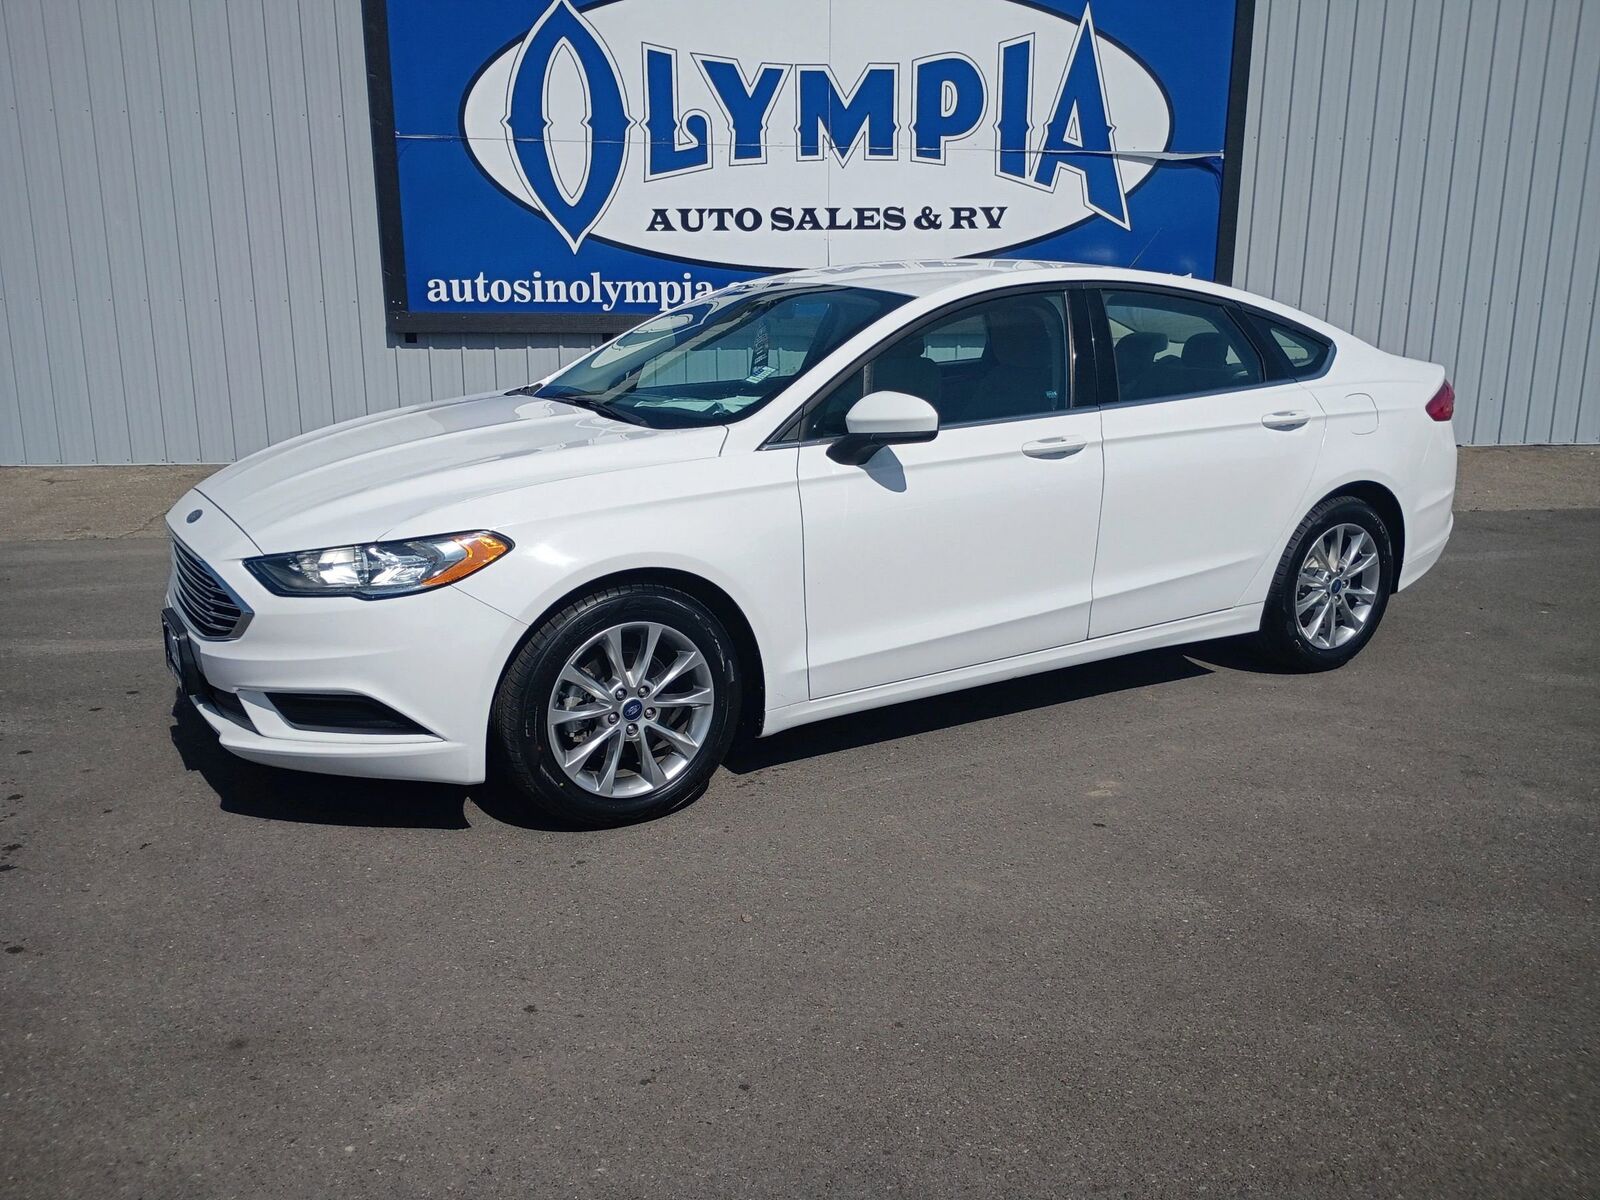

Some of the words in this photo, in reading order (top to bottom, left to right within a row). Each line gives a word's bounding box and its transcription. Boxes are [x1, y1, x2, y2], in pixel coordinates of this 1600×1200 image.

[501, 0, 1131, 254] OLYMPIA
[645, 207, 763, 232] AUTO
[769, 206, 907, 231] SALES
[913, 205, 943, 231] &
[948, 206, 1009, 230] RV
[427, 271, 742, 311] autosinolympia
